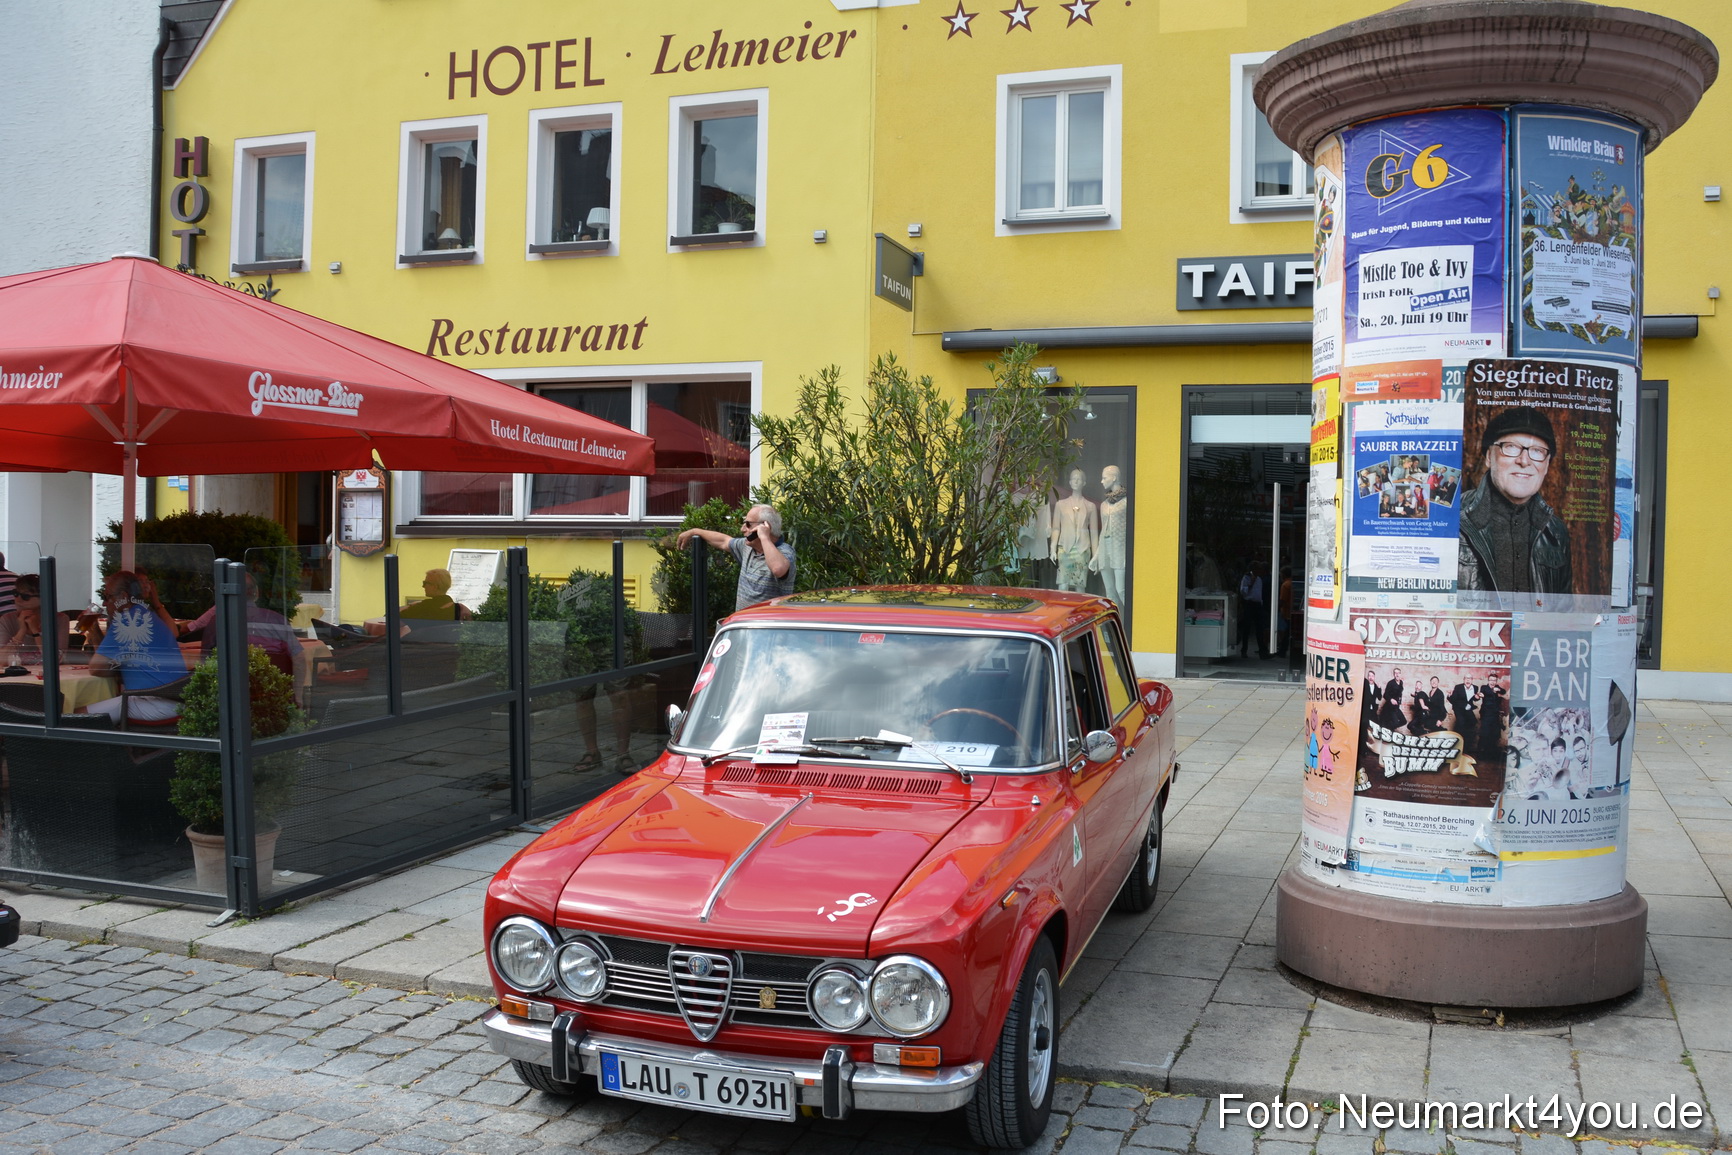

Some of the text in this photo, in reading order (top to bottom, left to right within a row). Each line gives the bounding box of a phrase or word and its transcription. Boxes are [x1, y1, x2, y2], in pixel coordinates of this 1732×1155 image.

[448, 20, 857, 100] HOTEL Lehmeier
[1547, 135, 1592, 153] Winkler
[1594, 140, 1614, 158] Bräu
[1365, 143, 1449, 199] G6
[1351, 215, 1492, 240] Haus für Jugend, Bildung und Kultur
[1534, 240, 1548, 252] 36.
[1550, 241, 1601, 257] Lengenfelder
[1363, 258, 1468, 284] Mistle Toe & Ivy
[1564, 256, 1569, 264] 3.
[1570, 256, 1581, 265] Juni
[1583, 257, 1591, 265] bis
[1596, 259, 1606, 268] Juni
[1607, 261, 1616, 269] 2015
[883, 274, 911, 301] TAIFUN
[1181, 261, 1314, 298] TAIF
[1362, 287, 1414, 301] Irish Folk
[1410, 293, 1444, 308] Open
[1447, 287, 1468, 300] Air
[1360, 311, 1469, 328] Sa., 20. Juni 19 Uhr
[425, 316, 649, 357] Restaurant
[1444, 339, 1484, 347] NEUMARKT
[1323, 340, 1334, 352] 2015
[1473, 363, 1614, 391] Siegfried Fietz
[248, 370, 364, 416] Glossner-Bier
[1476, 388, 1611, 404] Von guten Mächten wunderbar geborgen
[1521, 400, 1550, 408] Siegfried
[1580, 422, 1599, 432] Freitag
[1581, 431, 1593, 439] Juni
[1594, 432, 1606, 440] 2015
[490, 419, 627, 460] Hotel Restaurant Lehmeier
[1360, 441, 1458, 452] SAUBER BRAZZELT
[1319, 447, 1335, 461] 2015
[1575, 454, 1609, 463] Christuskirche
[1378, 577, 1452, 590] NEW BERLIN CLUB
[1353, 617, 1506, 648] SIX PACK
[1365, 649, 1506, 663] APPELLA-COMEDY-SHOW
[1556, 638, 1590, 668] BR
[1522, 671, 1588, 701] BAN
[1391, 745, 1460, 759] DERASSA
[1382, 756, 1446, 778] BUMM
[1383, 811, 1475, 826] Rathausinnenhof Berching
[1525, 809, 1556, 827] JUNI
[1561, 807, 1591, 823] 2015
[1592, 814, 1605, 822] OPEN
[1593, 806, 1604, 814] BURG
[1382, 819, 1406, 827] Sonntag,
[1407, 821, 1438, 830] 12.07.2015,
[1314, 840, 1343, 857] NEUMARKT
[608, 1074, 615, 1083] D
[620, 1061, 787, 1111] LAU T 693H
